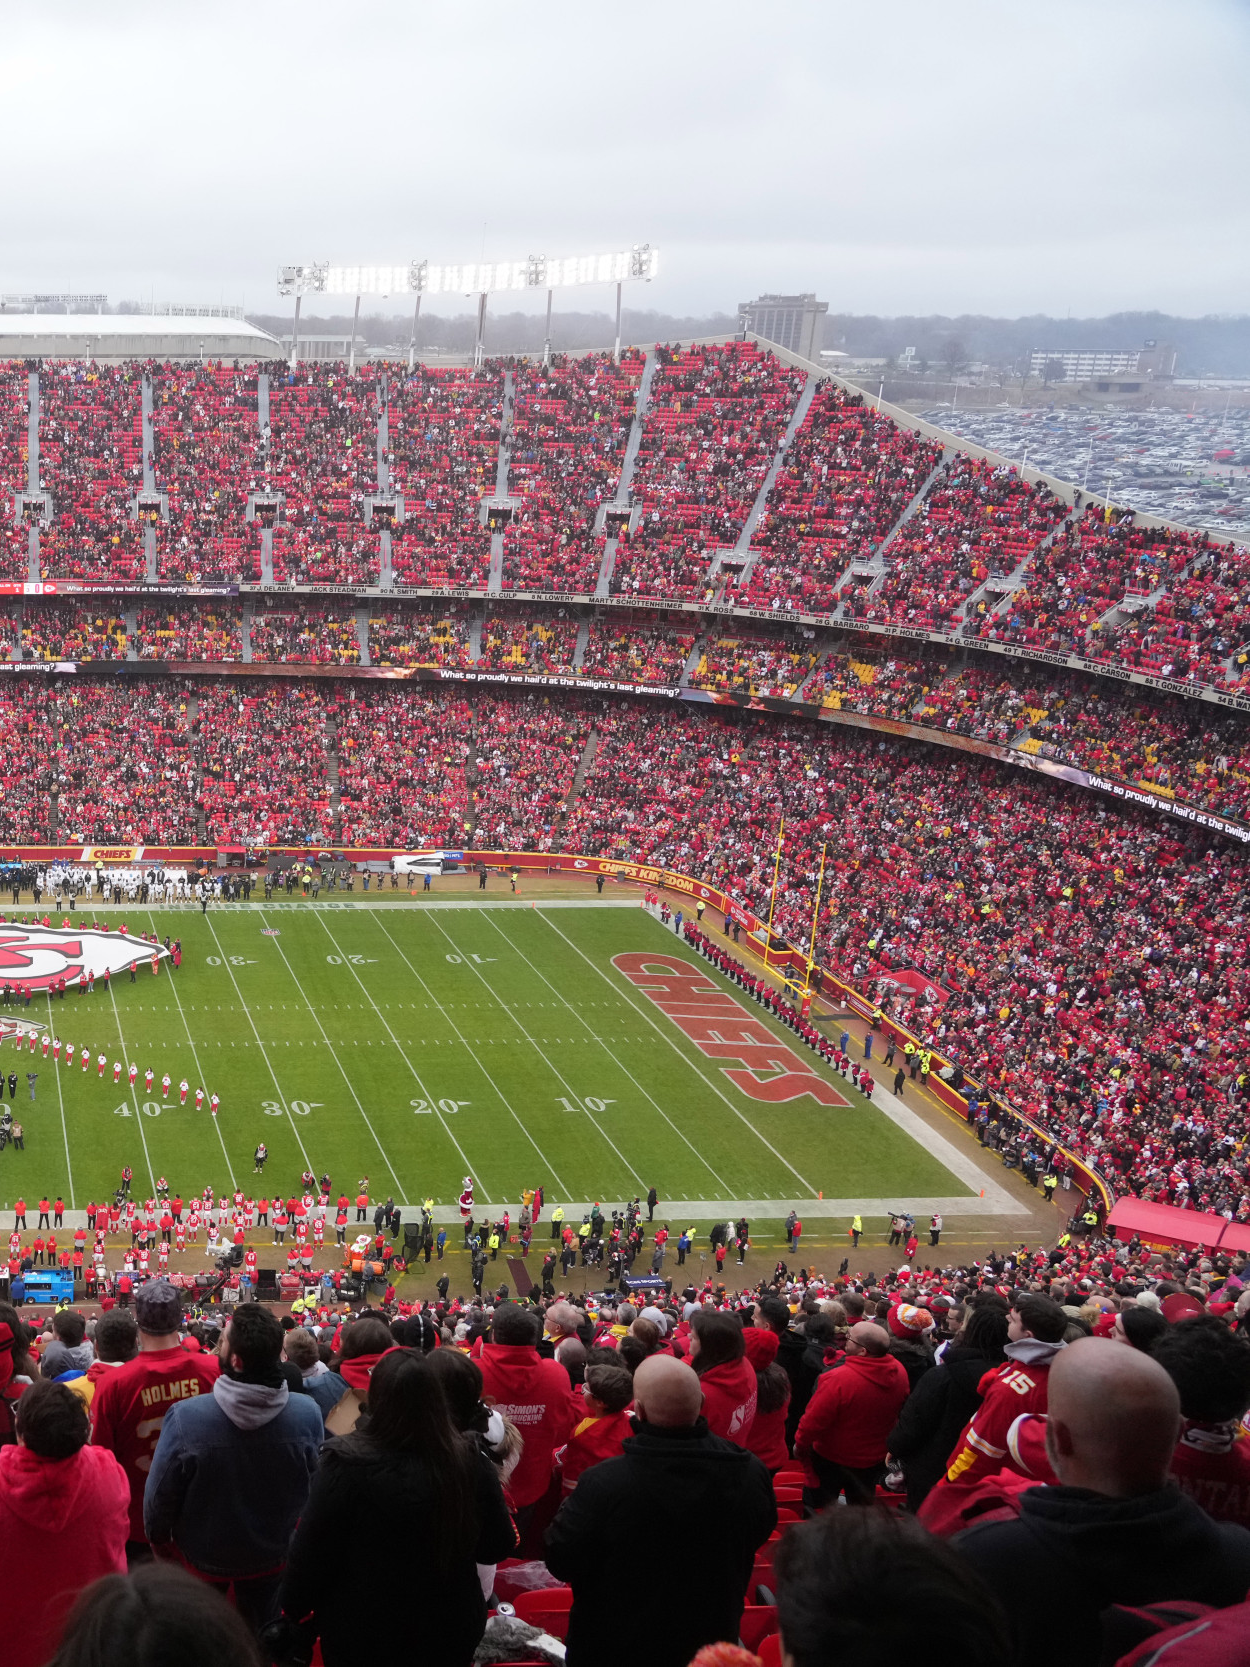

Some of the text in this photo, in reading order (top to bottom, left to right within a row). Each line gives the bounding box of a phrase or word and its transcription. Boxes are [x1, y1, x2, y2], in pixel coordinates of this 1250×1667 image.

[616, 599, 683, 609] SCHOTTENHEIMER
[768, 612, 800, 622] SHIELDS
[833, 621, 870, 630] BARBARO
[900, 630, 930, 639] HOLMES
[964, 639, 989, 649] GREEN
[1022, 650, 1068, 665] RICHARDSON
[15, 662, 55, 672] gleaming?
[1100, 667, 1131, 680] CARSON
[441, 671, 464, 680] What
[478, 673, 509, 682] proudly
[525, 675, 546, 684] hail'd
[560, 677, 574, 686] the
[576, 679, 615, 690] twilight's
[617, 682, 633, 691] last
[635, 685, 679, 697] gleaming?
[1161, 682, 1203, 698] GONZALEZ
[1089, 776, 1112, 791] What
[1113, 786, 1124, 794] so
[1125, 790, 1157, 808] proudly
[1158, 802, 1172, 811] we
[1173, 805, 1196, 820] hail'd
[1197, 815, 1207, 824] at
[1208, 818, 1223, 830] the
[94, 850, 132, 858] CHIEFS
[599, 862, 638, 877] CHIEFS
[206, 955, 245, 966] 30
[326, 954, 366, 965] 20
[445, 954, 487, 964] 10
[610, 952, 855, 1108] CHIEFS
[113, 1102, 161, 1117] 40
[261, 1100, 311, 1116] 30
[410, 1099, 459, 1114] 20
[555, 1096, 607, 1112] 10
[1002, 1370, 1036, 1395] 15
[141, 1378, 200, 1407] HOLMES
[508, 1404, 546, 1415] SIMON'S
